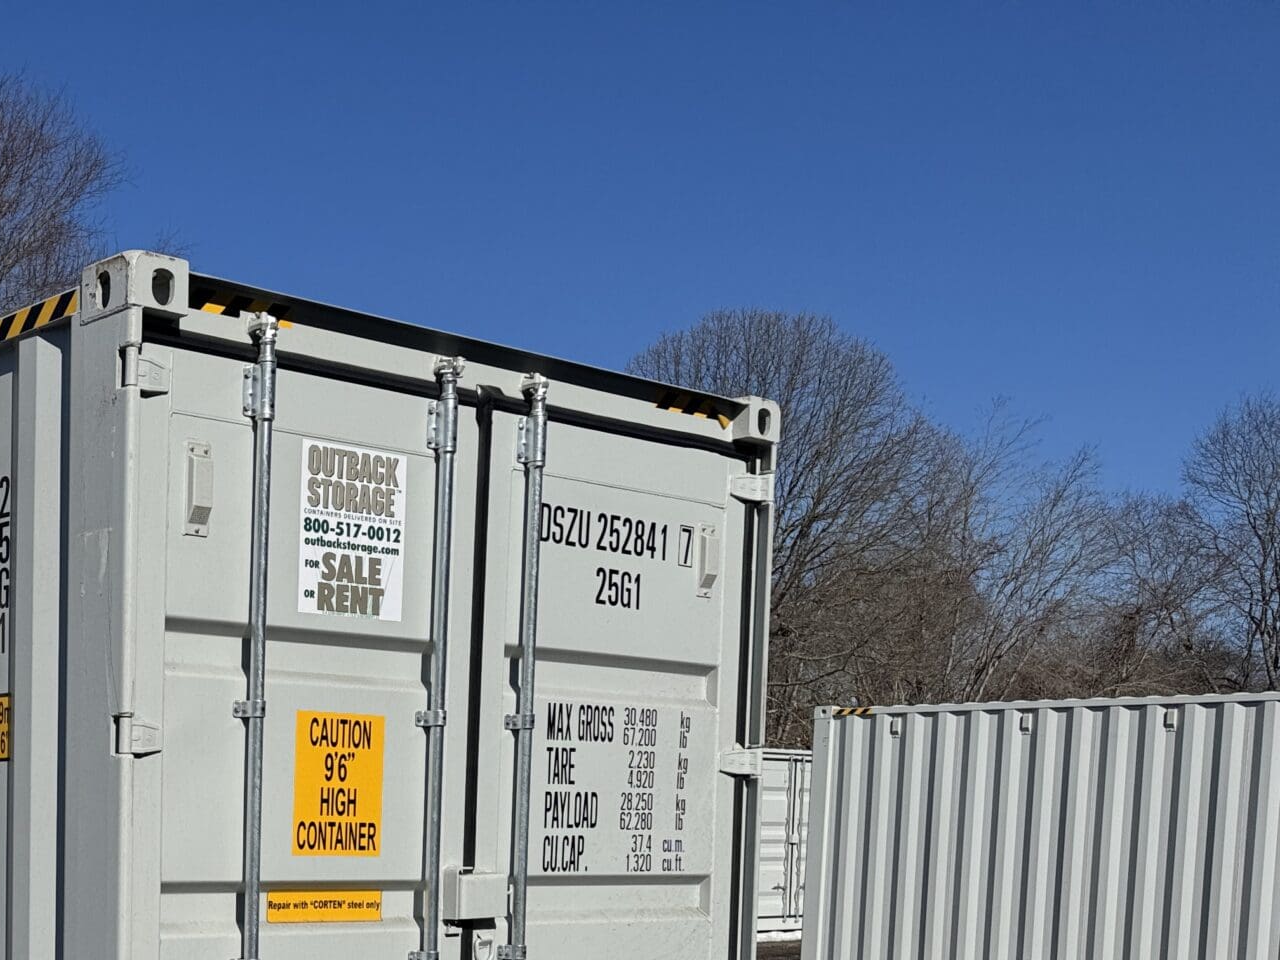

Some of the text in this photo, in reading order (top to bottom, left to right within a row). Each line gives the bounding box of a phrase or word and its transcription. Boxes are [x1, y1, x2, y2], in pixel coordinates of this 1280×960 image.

[308, 444, 399, 488] OUTBACK
[307, 476, 395, 518] STORAGE
[304, 507, 342, 519] CONTAINERS
[343, 513, 377, 523] DELIVERED
[304, 516, 402, 544] 800-517-0012
[304, 535, 400, 556] outbackstorage.com
[540, 502, 693, 565] DSZU 252841 7
[0, 476, 10, 655] 25G1
[304, 551, 382, 587] FOR SALE
[304, 582, 385, 616] OR RENT
[594, 566, 642, 611] 25G1
[310, 717, 372, 749] CAUTION
[546, 702, 573, 741] MAX
[578, 704, 615, 742] GROSS
[680, 711, 691, 733] kg
[679, 730, 688, 749] lb
[324, 752, 355, 782] 9'6"
[546, 747, 577, 785] TARE
[677, 752, 689, 774] kg
[676, 772, 685, 789] lb
[320, 787, 357, 817] HIGH
[544, 791, 598, 829] PAYLOAD
[675, 793, 686, 815] kg
[296, 821, 376, 851] CONTAINER
[675, 812, 683, 831] lb
[631, 834, 652, 853] 37.4
[662, 854, 685, 872] cu.ft.
[268, 900, 380, 911] Repair with "CORTEN" steel only
